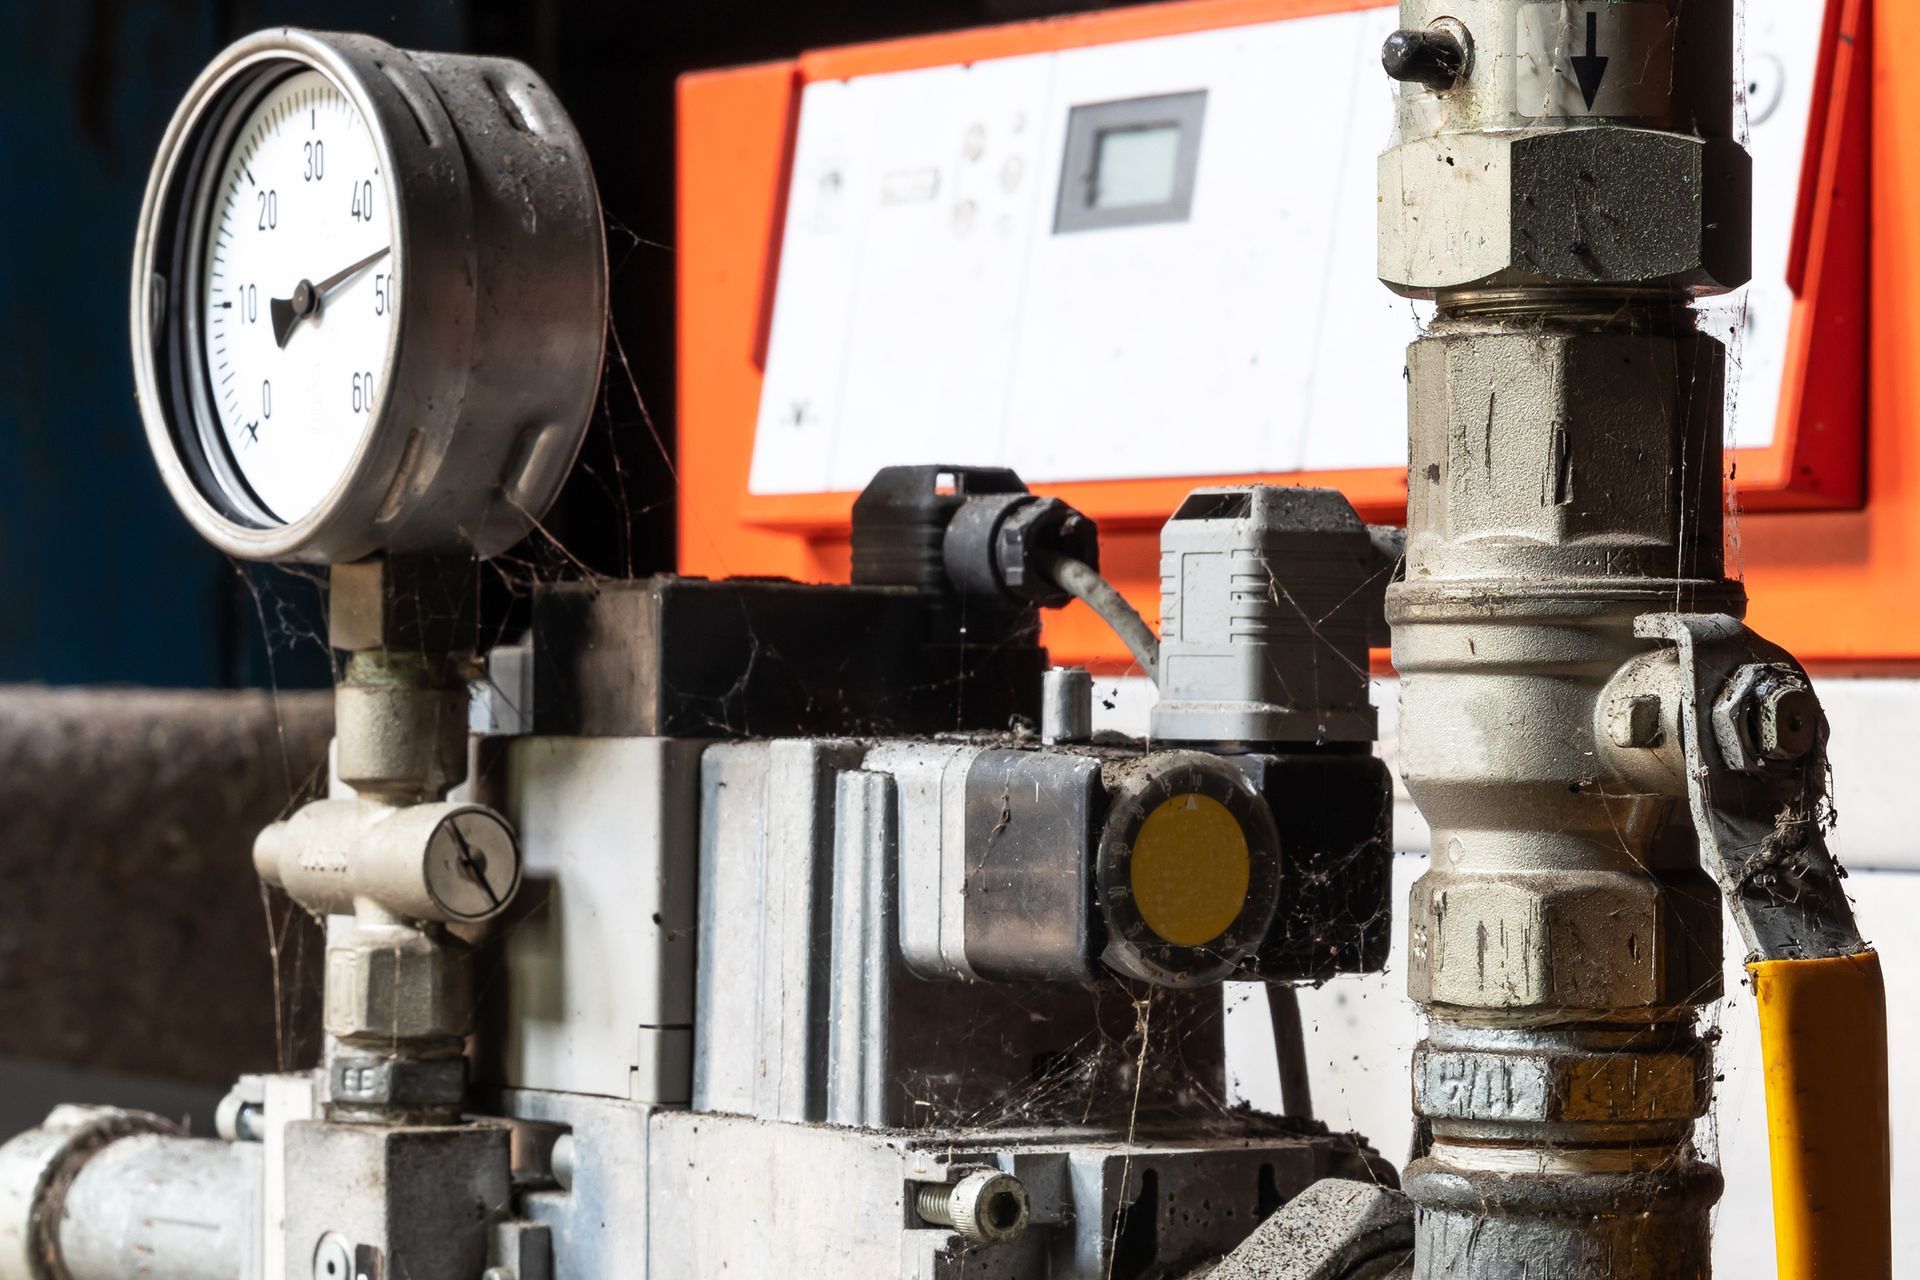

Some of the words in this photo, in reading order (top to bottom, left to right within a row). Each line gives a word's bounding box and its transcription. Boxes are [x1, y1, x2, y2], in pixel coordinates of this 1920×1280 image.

[304, 140, 323, 182] 30
[258, 189, 277, 231] 20
[351, 180, 372, 222] 40
[239, 283, 257, 324] 10
[262, 379, 272, 420] 0
[352, 371, 374, 414] 60
[1160, 776, 1172, 793] 15
[1192, 774, 1203, 786] 10
